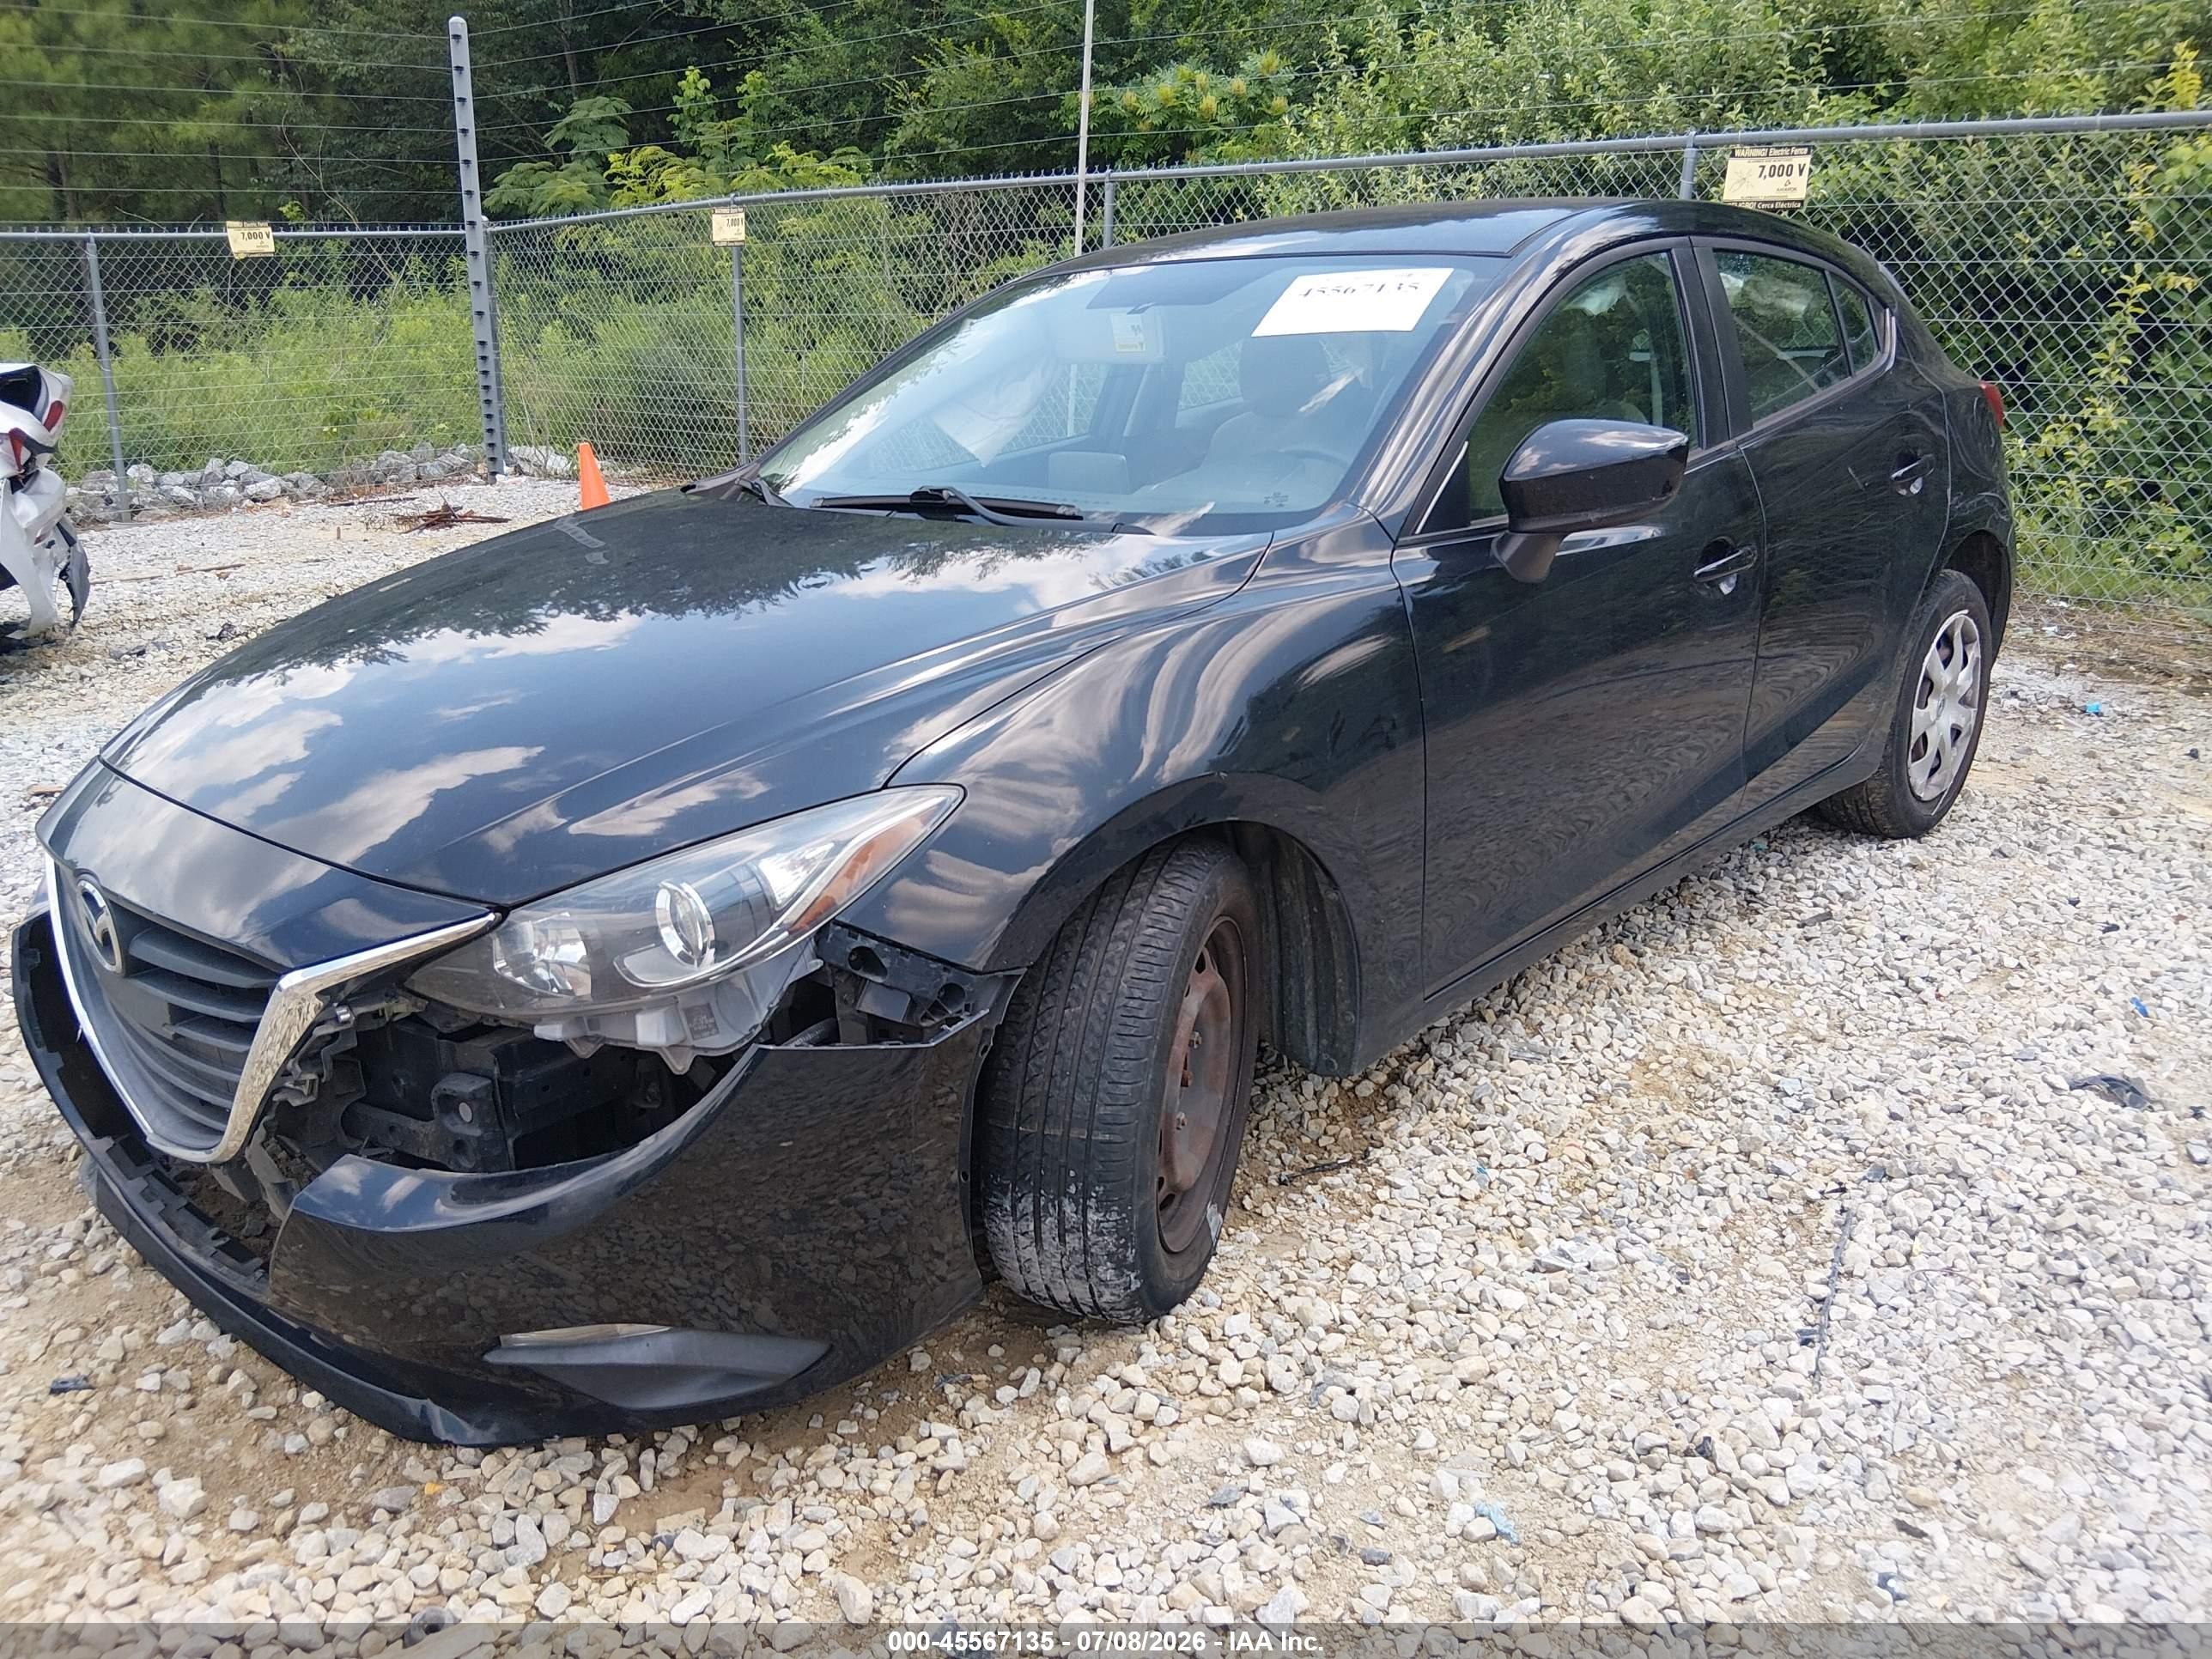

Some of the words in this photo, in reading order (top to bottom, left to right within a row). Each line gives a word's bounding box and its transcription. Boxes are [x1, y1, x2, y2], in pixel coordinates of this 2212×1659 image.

[1735, 148, 1768, 157] WARNING!
[1769, 148, 1790, 156] Electric
[1790, 147, 1808, 155] Fence
[1758, 164, 1794, 180] 7,000
[1798, 163, 1807, 177] V
[240, 232, 264, 241] 7,000
